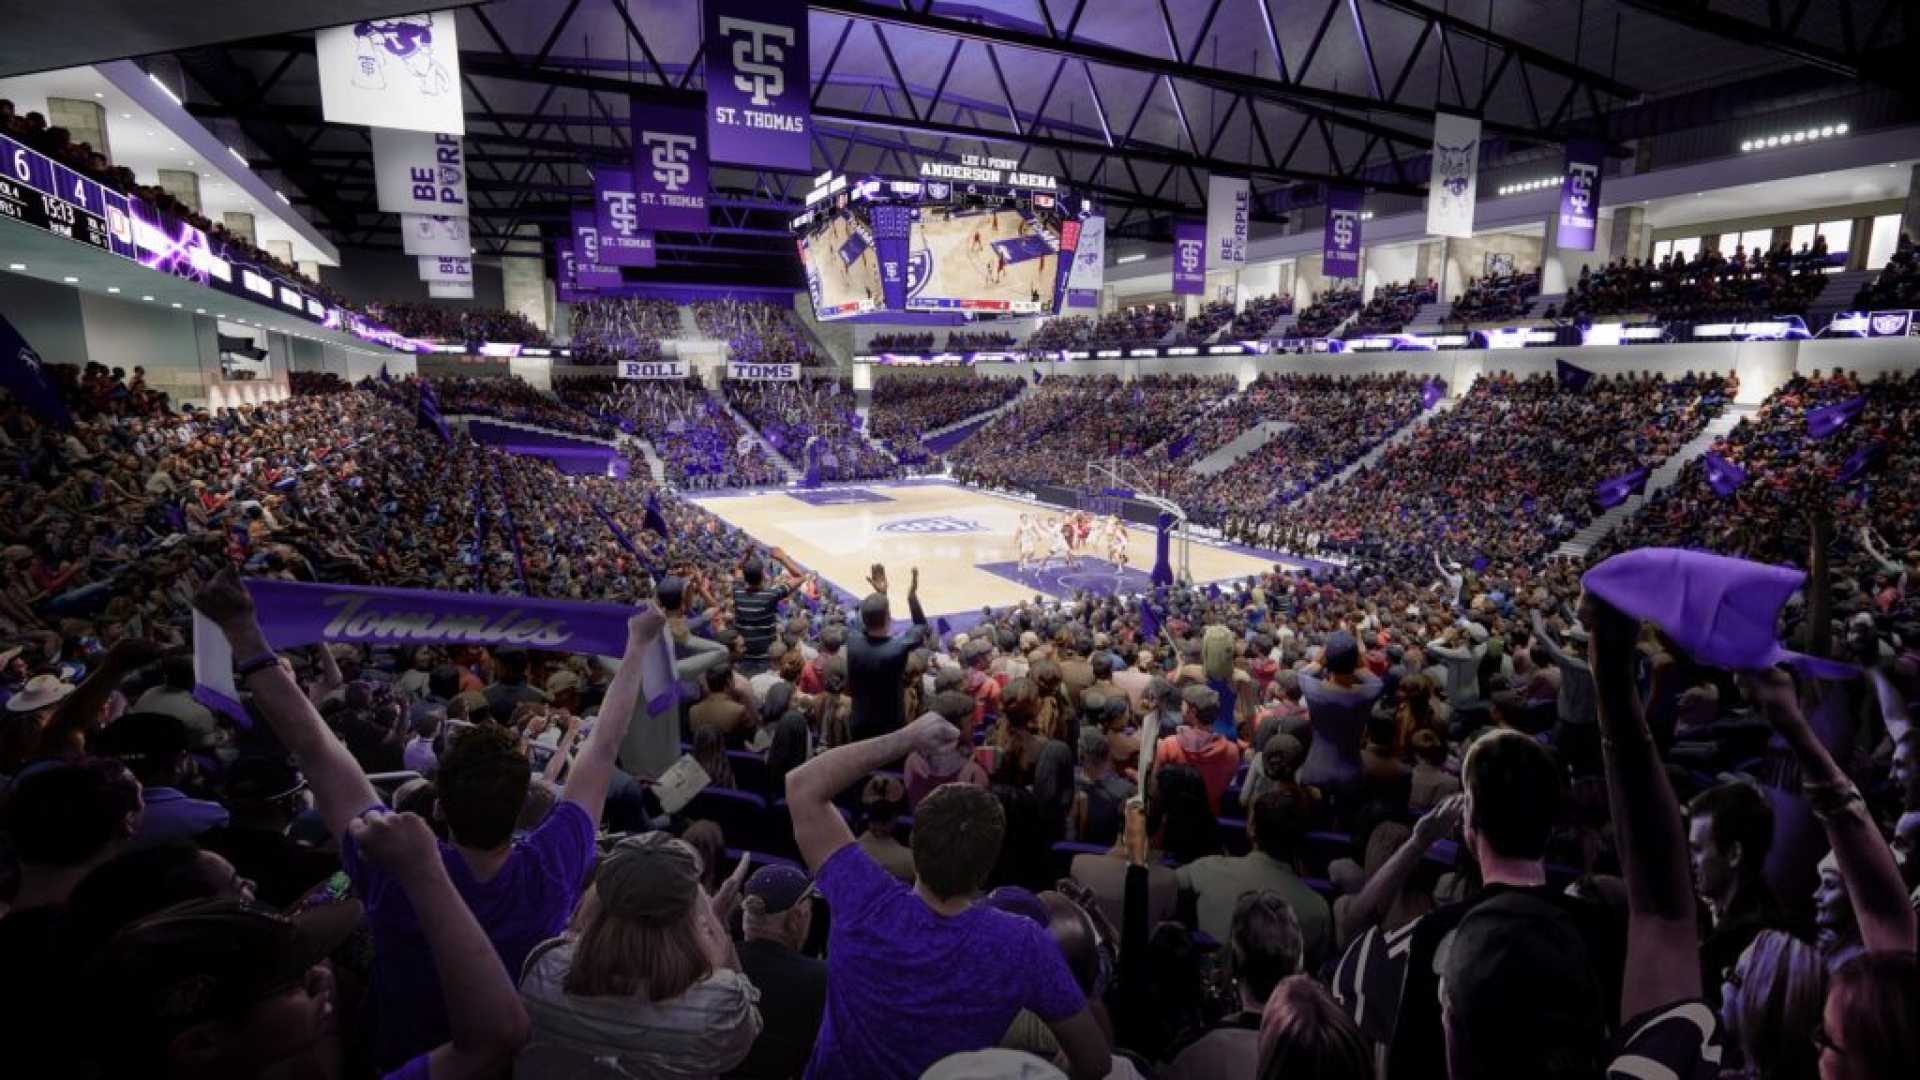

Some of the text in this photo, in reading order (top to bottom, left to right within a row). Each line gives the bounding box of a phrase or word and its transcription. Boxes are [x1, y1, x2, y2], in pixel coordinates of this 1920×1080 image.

[715, 106, 804, 133] ST. THOMAS
[15, 149, 31, 181] 6
[920, 162, 1057, 189] ANDERSON ARENA
[74, 179, 87, 207] 4
[410, 166, 437, 202] BE
[661, 194, 704, 209] THOMAS
[625, 362, 683, 376] ROLL
[734, 364, 793, 378] TOMS
[323, 594, 575, 645] Tommies
